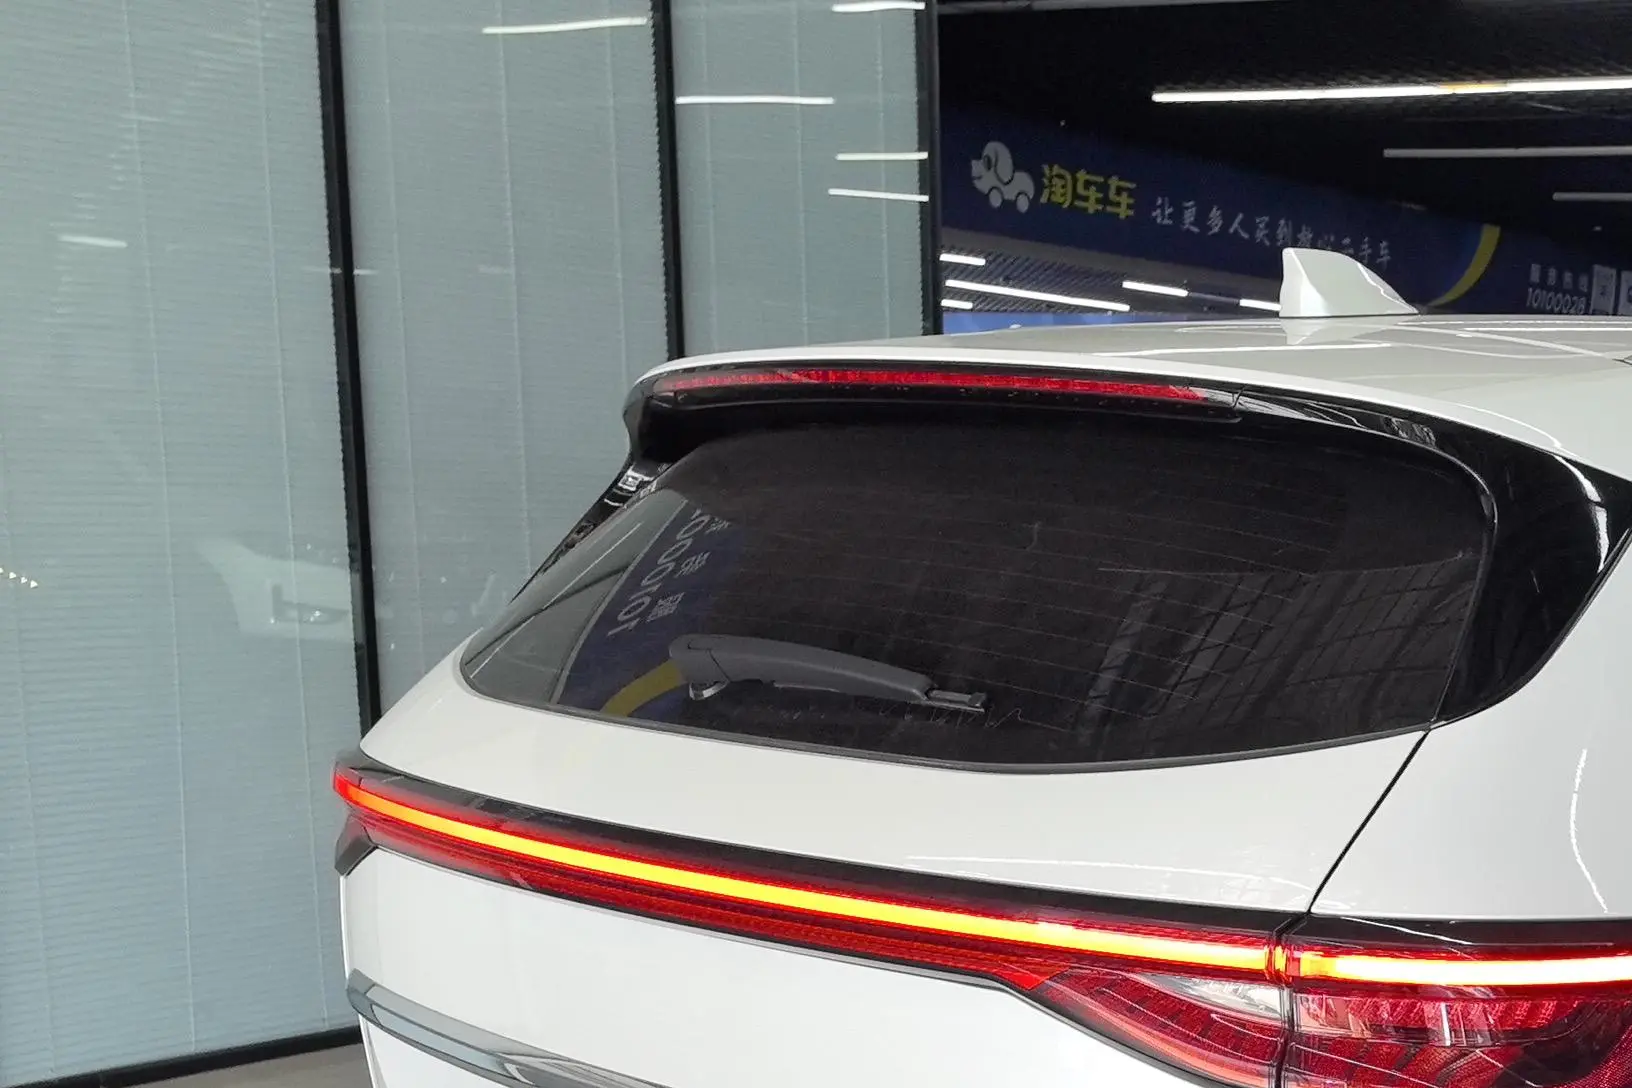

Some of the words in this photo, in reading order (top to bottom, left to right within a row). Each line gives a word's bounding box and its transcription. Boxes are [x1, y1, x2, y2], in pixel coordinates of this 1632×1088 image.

[1040, 164, 1137, 219] 淘车车
[1526, 287, 1587, 315] 10100028
